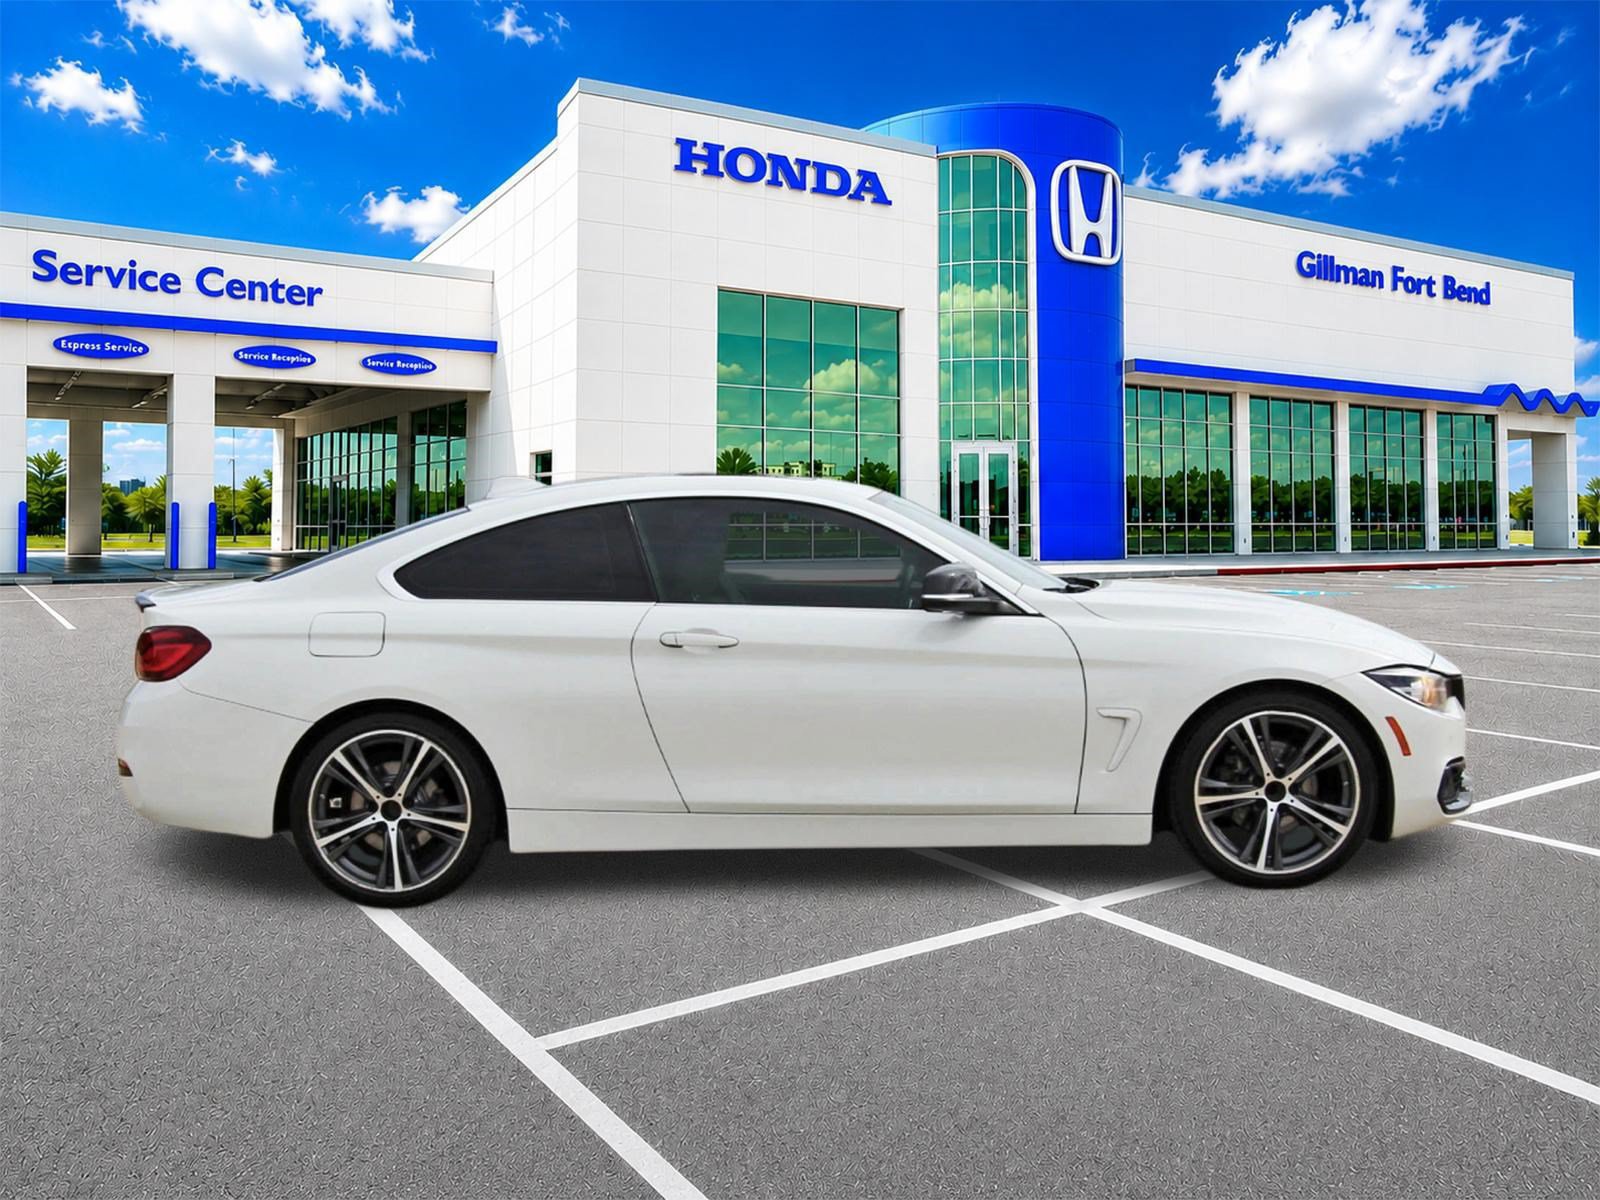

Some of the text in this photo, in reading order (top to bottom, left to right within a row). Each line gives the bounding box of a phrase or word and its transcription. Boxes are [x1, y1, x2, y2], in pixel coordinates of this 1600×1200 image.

[674, 137, 893, 206] HONDA
[31, 249, 323, 307] Service Center
[1295, 250, 1491, 305] Gillman Fort Bend
[104, 342, 144, 354] Service
[238, 351, 270, 361] Service
[366, 358, 395, 368] Service
